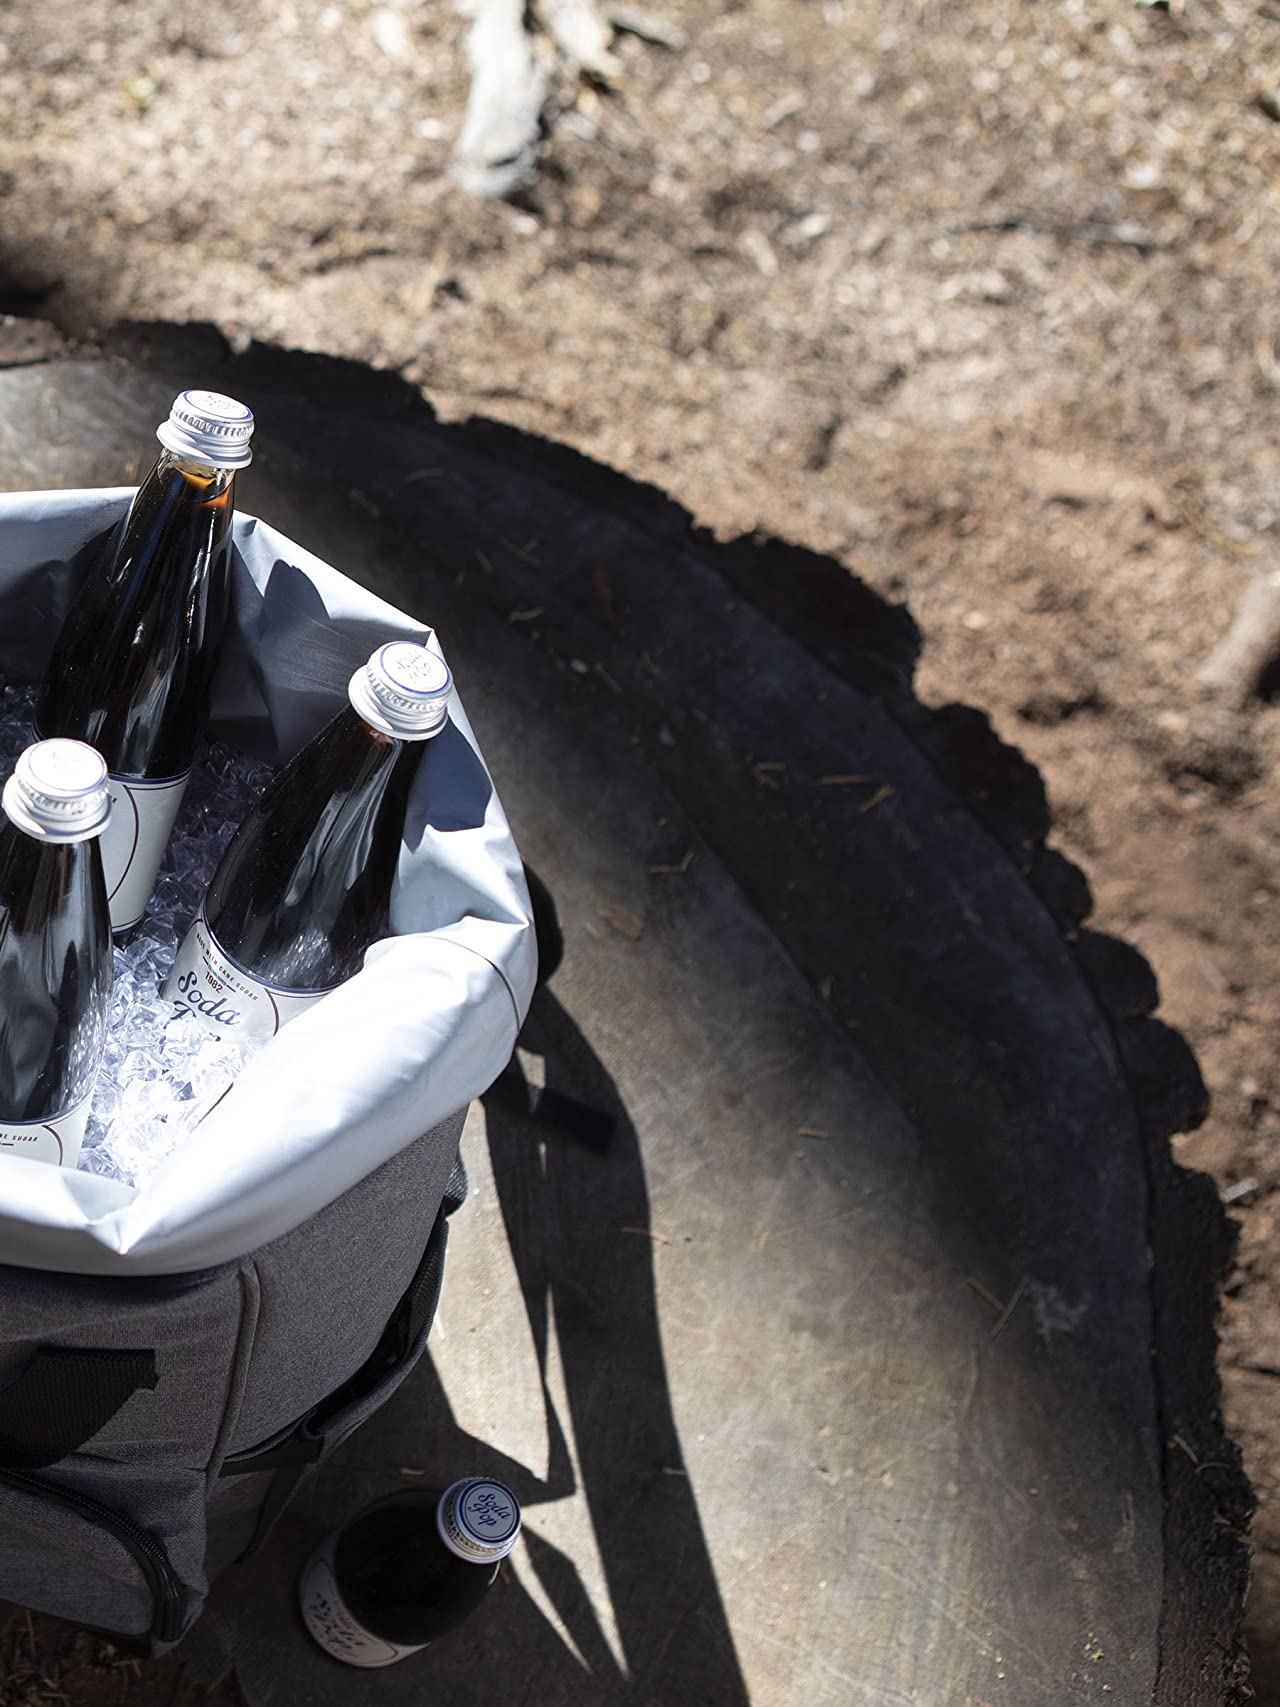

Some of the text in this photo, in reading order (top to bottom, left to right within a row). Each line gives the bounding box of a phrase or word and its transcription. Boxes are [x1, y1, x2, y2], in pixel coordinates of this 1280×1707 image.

[205, 971, 224, 995] 1982
[219, 967, 235, 983] CANE
[236, 982, 258, 1001] SUGAR
[177, 970, 241, 1026] Soda
[12, 1134, 39, 1143] SUGAR
[467, 1502, 497, 1527] Pop
[477, 1493, 511, 1520] Soda
